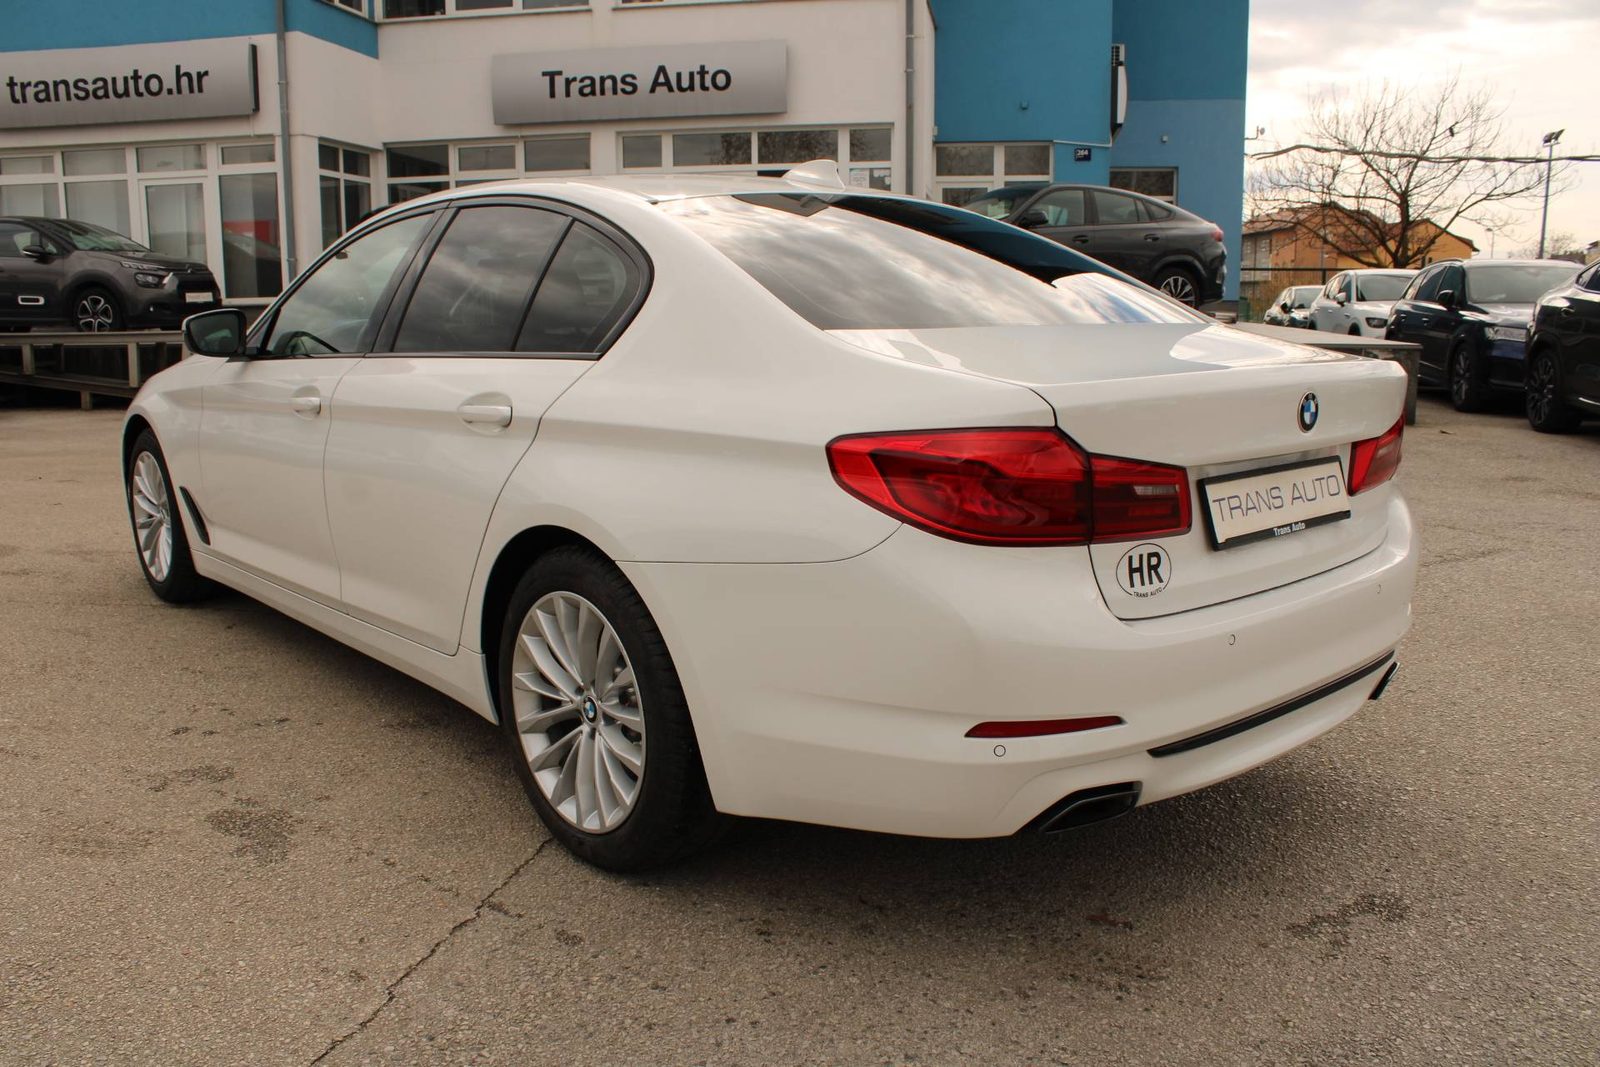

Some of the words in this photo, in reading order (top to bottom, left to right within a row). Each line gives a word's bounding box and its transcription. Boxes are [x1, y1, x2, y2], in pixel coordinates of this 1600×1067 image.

[6, 64, 208, 104] transauto.hr
[541, 70, 638, 99] Trans
[649, 65, 732, 94] Auto
[1212, 486, 1284, 521] TRANS
[1291, 474, 1341, 505] AUTO
[1273, 525, 1292, 536] Trans
[1291, 522, 1306, 532] Auto
[1128, 552, 1164, 588] HR
[1150, 587, 1163, 596] AUTO
